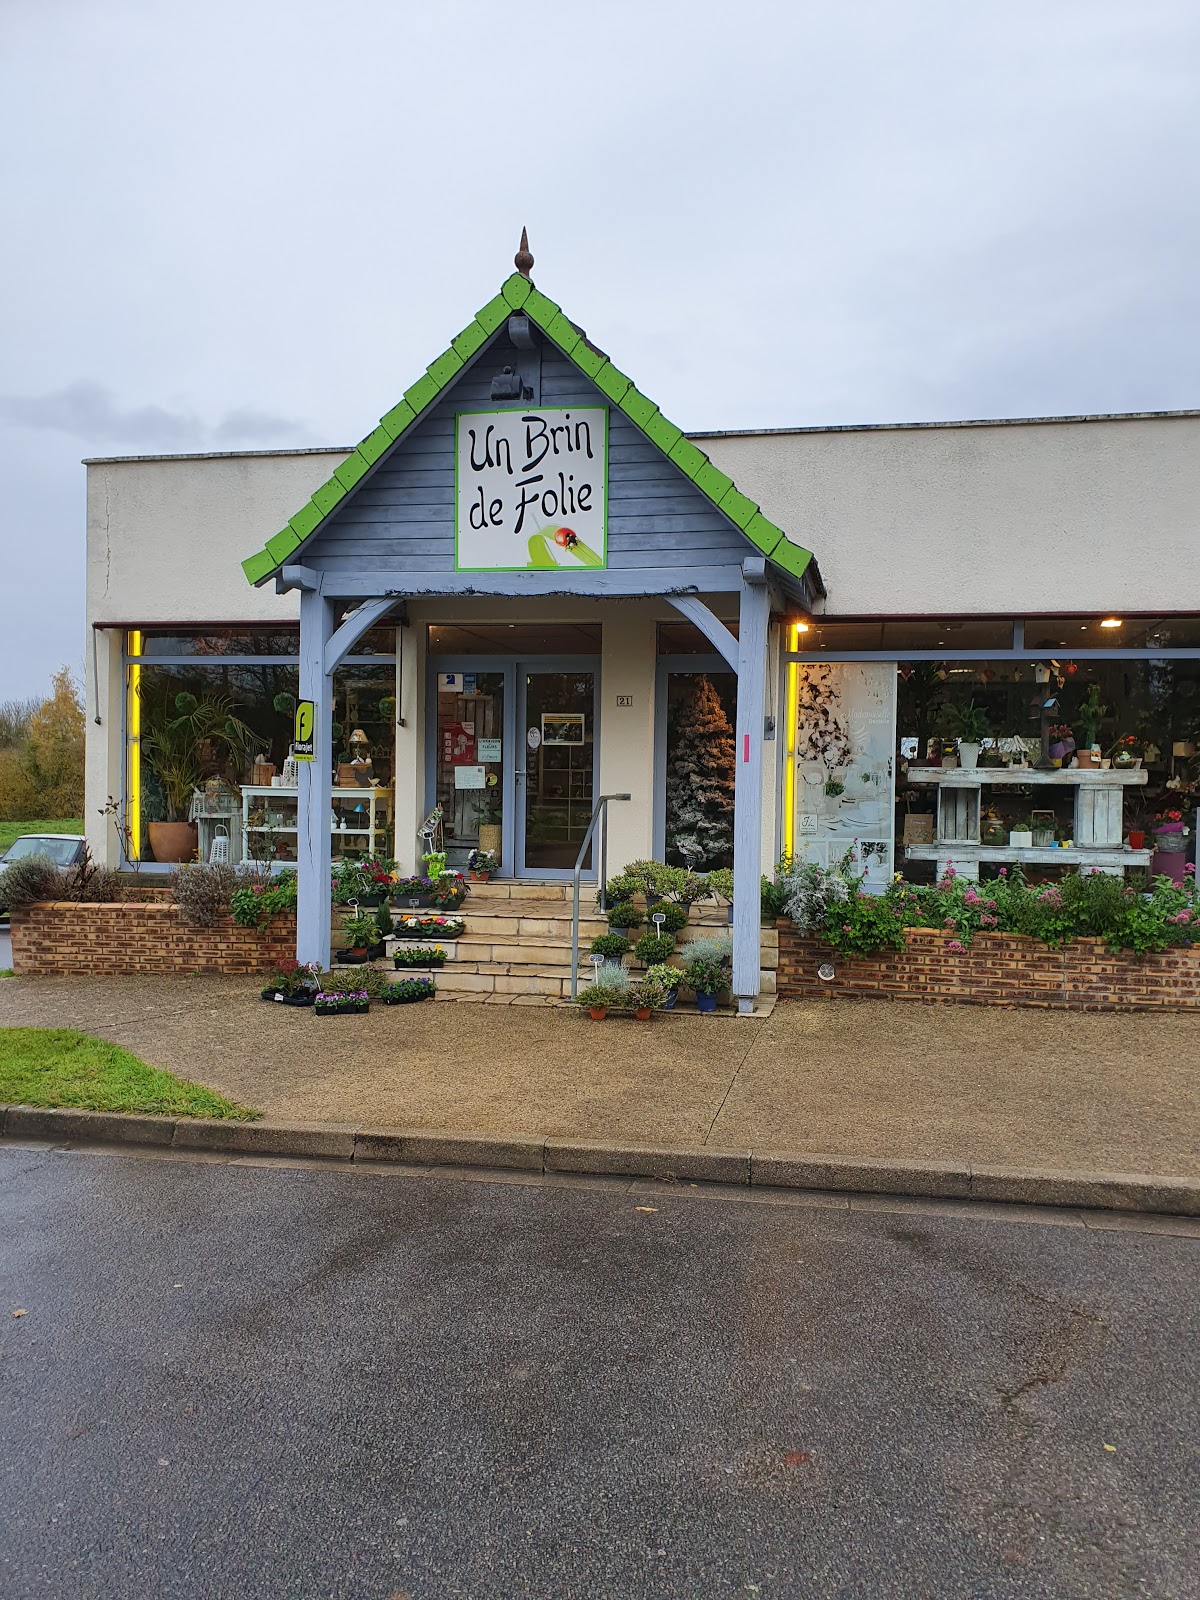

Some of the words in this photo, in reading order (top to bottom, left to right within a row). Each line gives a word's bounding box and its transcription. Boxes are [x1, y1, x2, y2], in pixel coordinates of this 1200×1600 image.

[468, 424, 514, 474] Un
[521, 413, 594, 473] Brin
[469, 485, 504, 530] de
[513, 471, 593, 534] Folie
